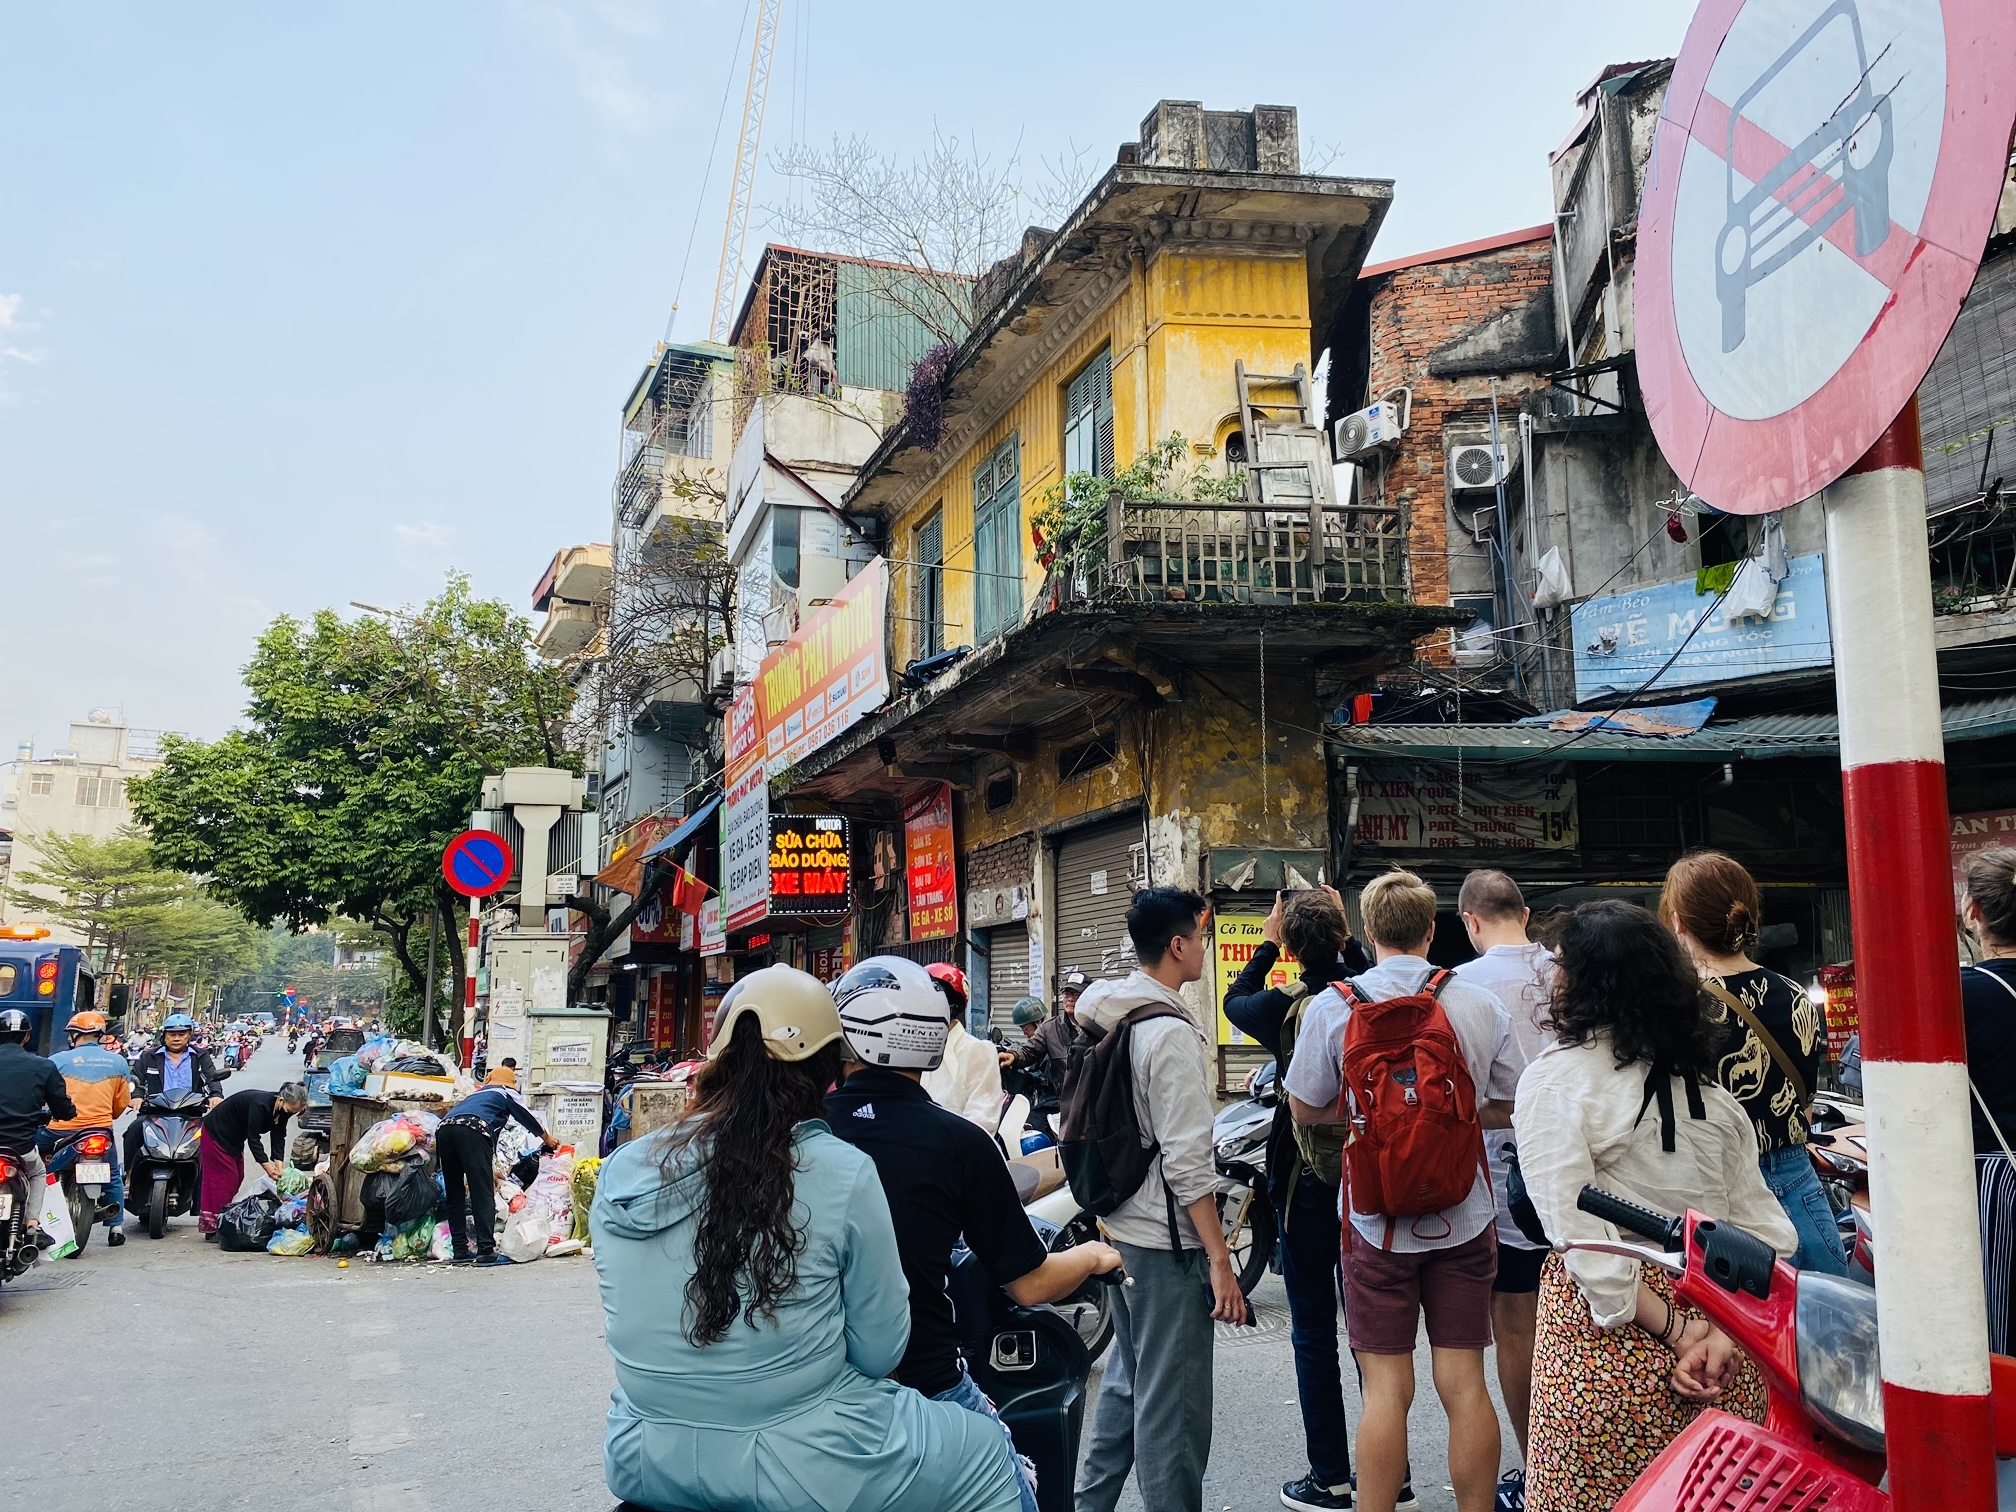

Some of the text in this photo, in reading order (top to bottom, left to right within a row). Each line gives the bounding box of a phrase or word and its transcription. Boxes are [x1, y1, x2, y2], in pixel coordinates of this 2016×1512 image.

[1618, 594, 1650, 611] Béo
[802, 617, 828, 692] PHÁT
[831, 584, 872, 674] MOTOR
[1665, 637, 1728, 655] TRANG
[1734, 630, 1772, 643] TÓC
[808, 729, 822, 750] 0967
[837, 709, 849, 730] 116
[1341, 776, 1415, 802] TỊT XIÊN
[1544, 789, 1561, 801] 7K
[816, 819, 842, 831] MOTOR
[1539, 811, 1572, 842] 15K
[1951, 816, 1989, 836] ÂN
[728, 841, 736, 863] XE
[736, 836, 744, 859] GA
[747, 829, 755, 851] XE
[755, 817, 763, 846] SỐ
[776, 830, 843, 849] SỬA CHỮA
[771, 849, 847, 868] BẢO DƯỠNG
[925, 853, 933, 866] XE
[730, 871, 736, 893] XE
[772, 868, 847, 894] XE MÁY
[912, 912, 921, 927] XE
[921, 910, 930, 925] GA
[934, 907, 943, 923] XE
[944, 901, 954, 921] SỐ
[1220, 923, 1237, 935] Cô
[852, 1111, 876, 1120] adidas
